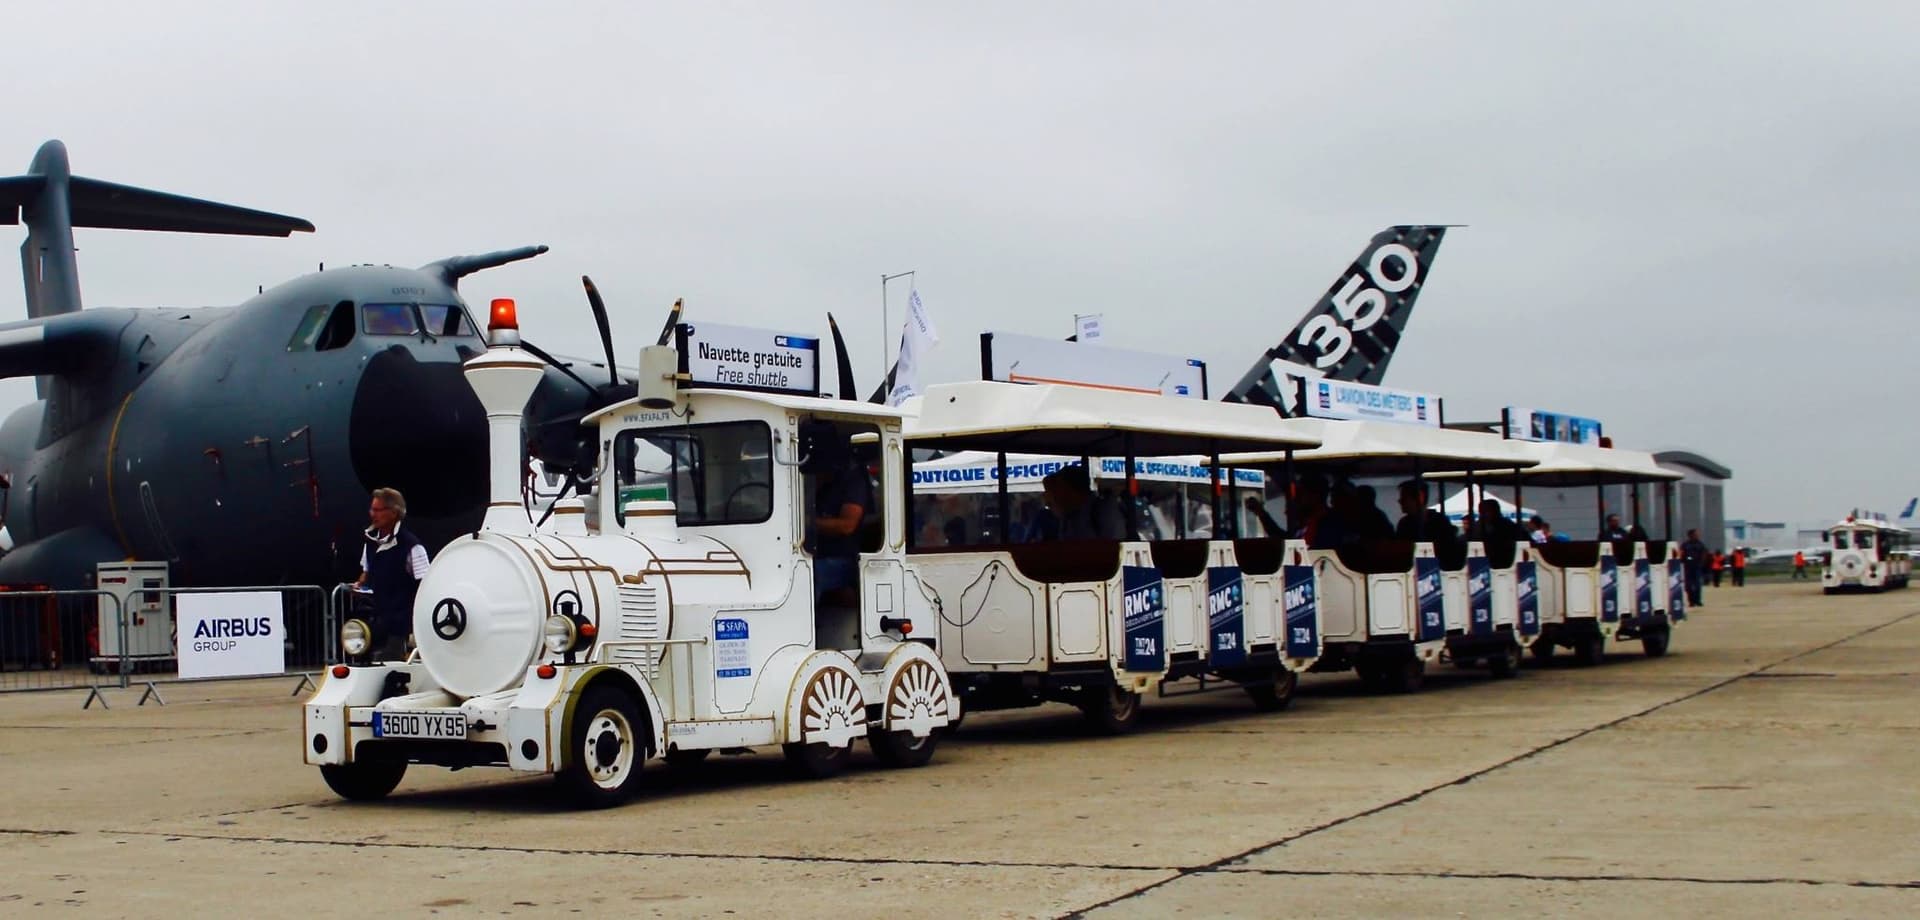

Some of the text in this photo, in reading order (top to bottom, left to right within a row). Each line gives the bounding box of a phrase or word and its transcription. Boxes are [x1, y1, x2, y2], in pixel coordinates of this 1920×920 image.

[1270, 244, 1418, 413] A350
[699, 342, 802, 369] Navette gratuite
[717, 365, 788, 387] Free shuttle
[912, 467, 985, 483] OUTIQUE
[1125, 589, 1150, 618] RMC
[1209, 586, 1232, 617] RMC
[1285, 584, 1306, 610] RMC
[194, 617, 271, 638] AIRBUS
[194, 640, 237, 652] GROUP
[1145, 638, 1156, 656] 24
[383, 716, 464, 737] 3600 YX 95
